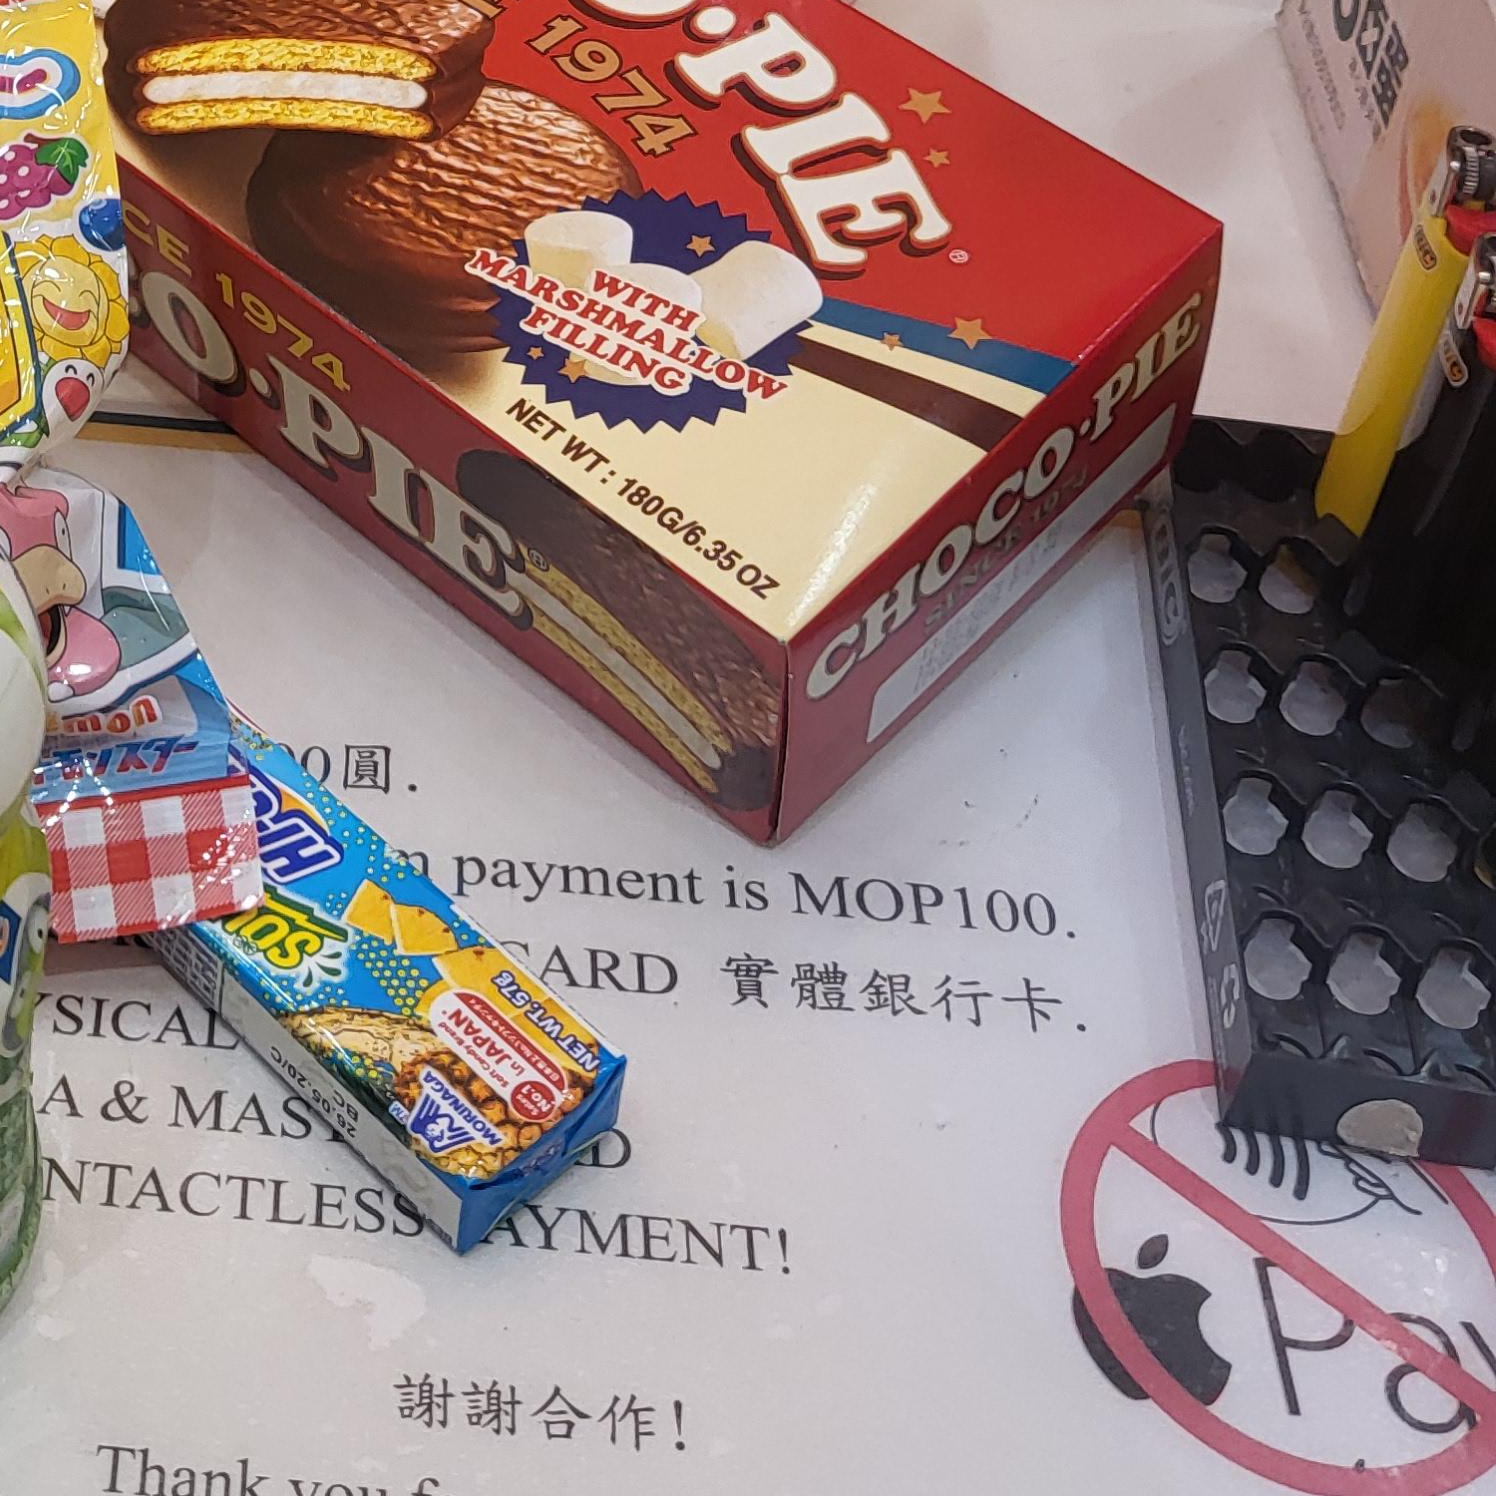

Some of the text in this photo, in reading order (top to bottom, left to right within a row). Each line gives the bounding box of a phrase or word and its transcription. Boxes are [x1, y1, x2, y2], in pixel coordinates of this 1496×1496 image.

[523, 13, 699, 158] 1974
[215, 271, 354, 394] 1974
[468, 248, 790, 401] MARSHMALLOW
[591, 269, 701, 333] WITH
[522, 307, 688, 392] FILLING
[505, 398, 566, 440] NET
[616, 477, 744, 574] 180G/6.35
[735, 560, 782, 601] OZ
[452, 852, 704, 906] payment
[722, 863, 770, 913] is
[790, 870, 1079, 940] MOP100.
[490, 970, 531, 1010] 57g
[558, 1035, 601, 1073] NET
[99, 1078, 149, 1125] &
[167, 1083, 344, 1144] MAS
[423, 1069, 503, 1147] MORINAGA
[42, 1156, 791, 1275] NTACTLESS AYMENT!
[393, 1371, 688, 1452] 謝謝合作!
[95, 1443, 272, 1496] Thank
